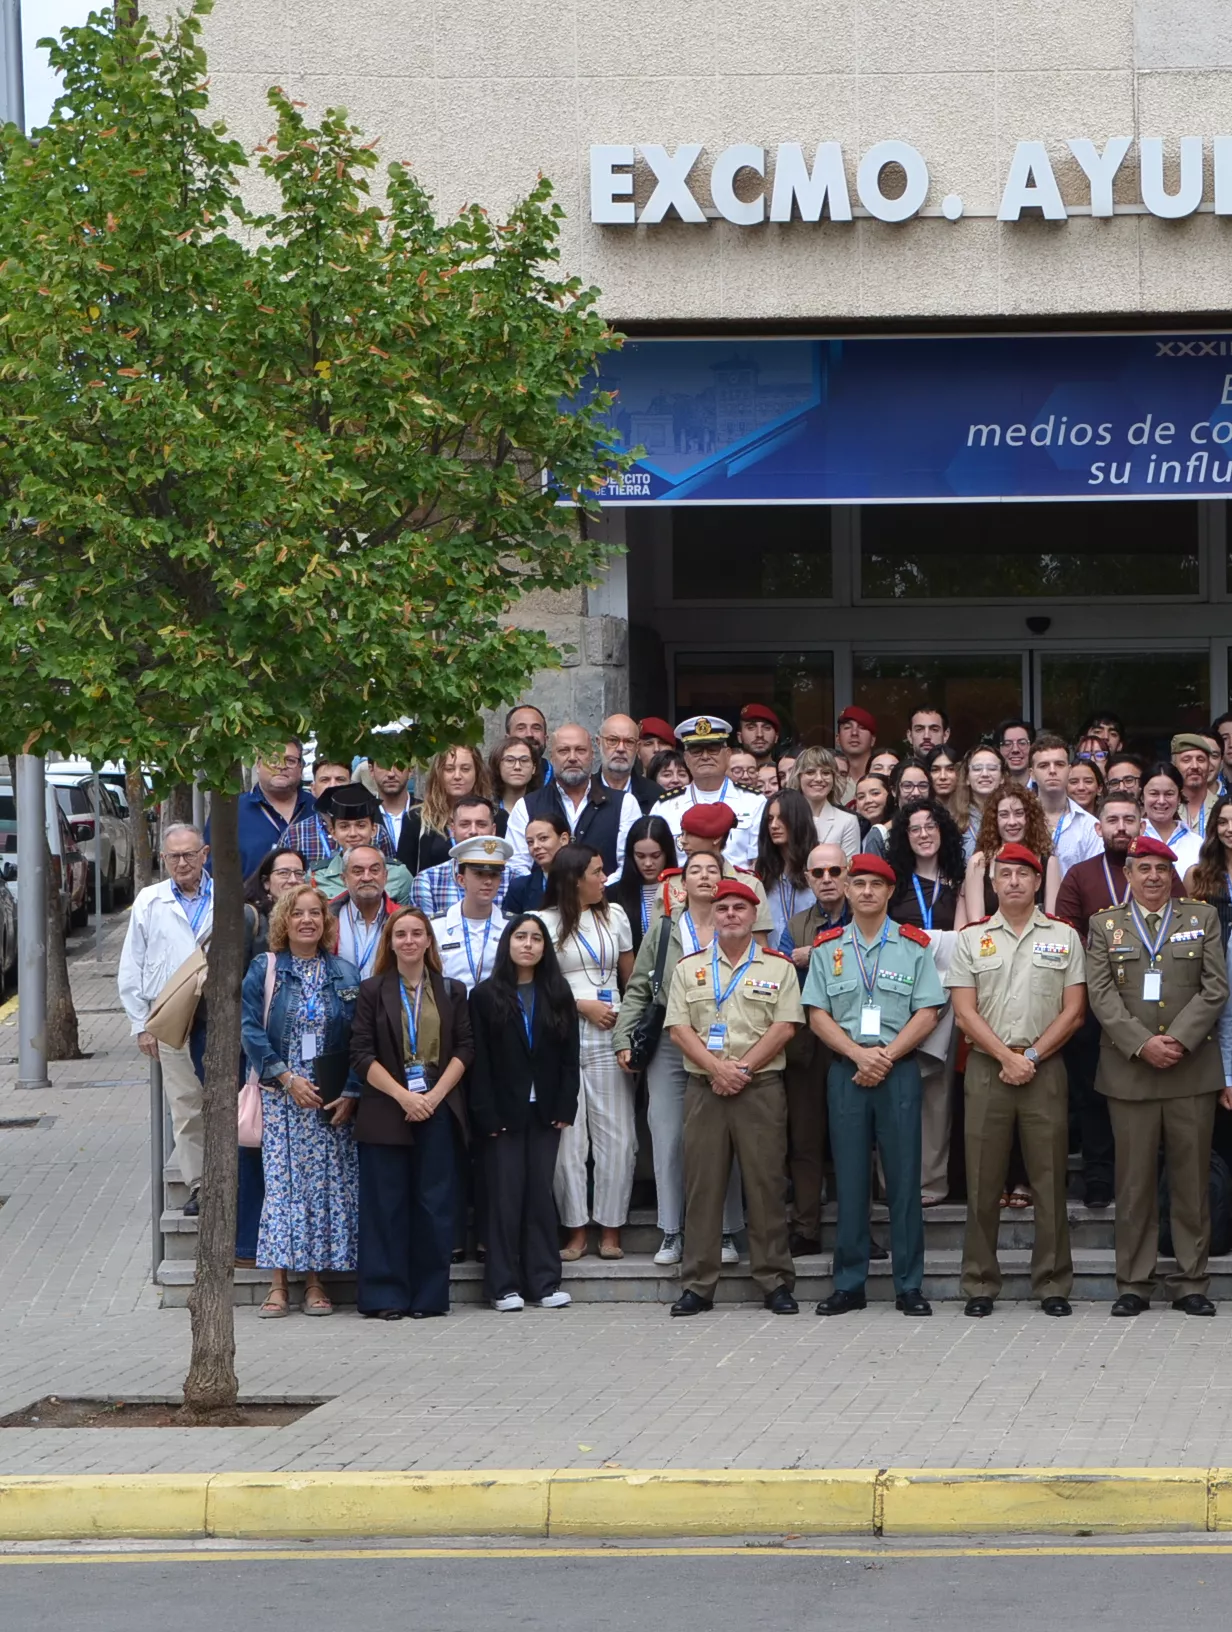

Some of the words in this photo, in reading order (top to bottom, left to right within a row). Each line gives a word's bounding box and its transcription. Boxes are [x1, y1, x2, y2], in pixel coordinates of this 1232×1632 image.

[590, 139, 964, 226] EXCMO.
[966, 414, 1113, 447] medios
[1127, 413, 1176, 445] de
[1088, 460, 1132, 485] su
[608, 485, 650, 495] TIERRA
